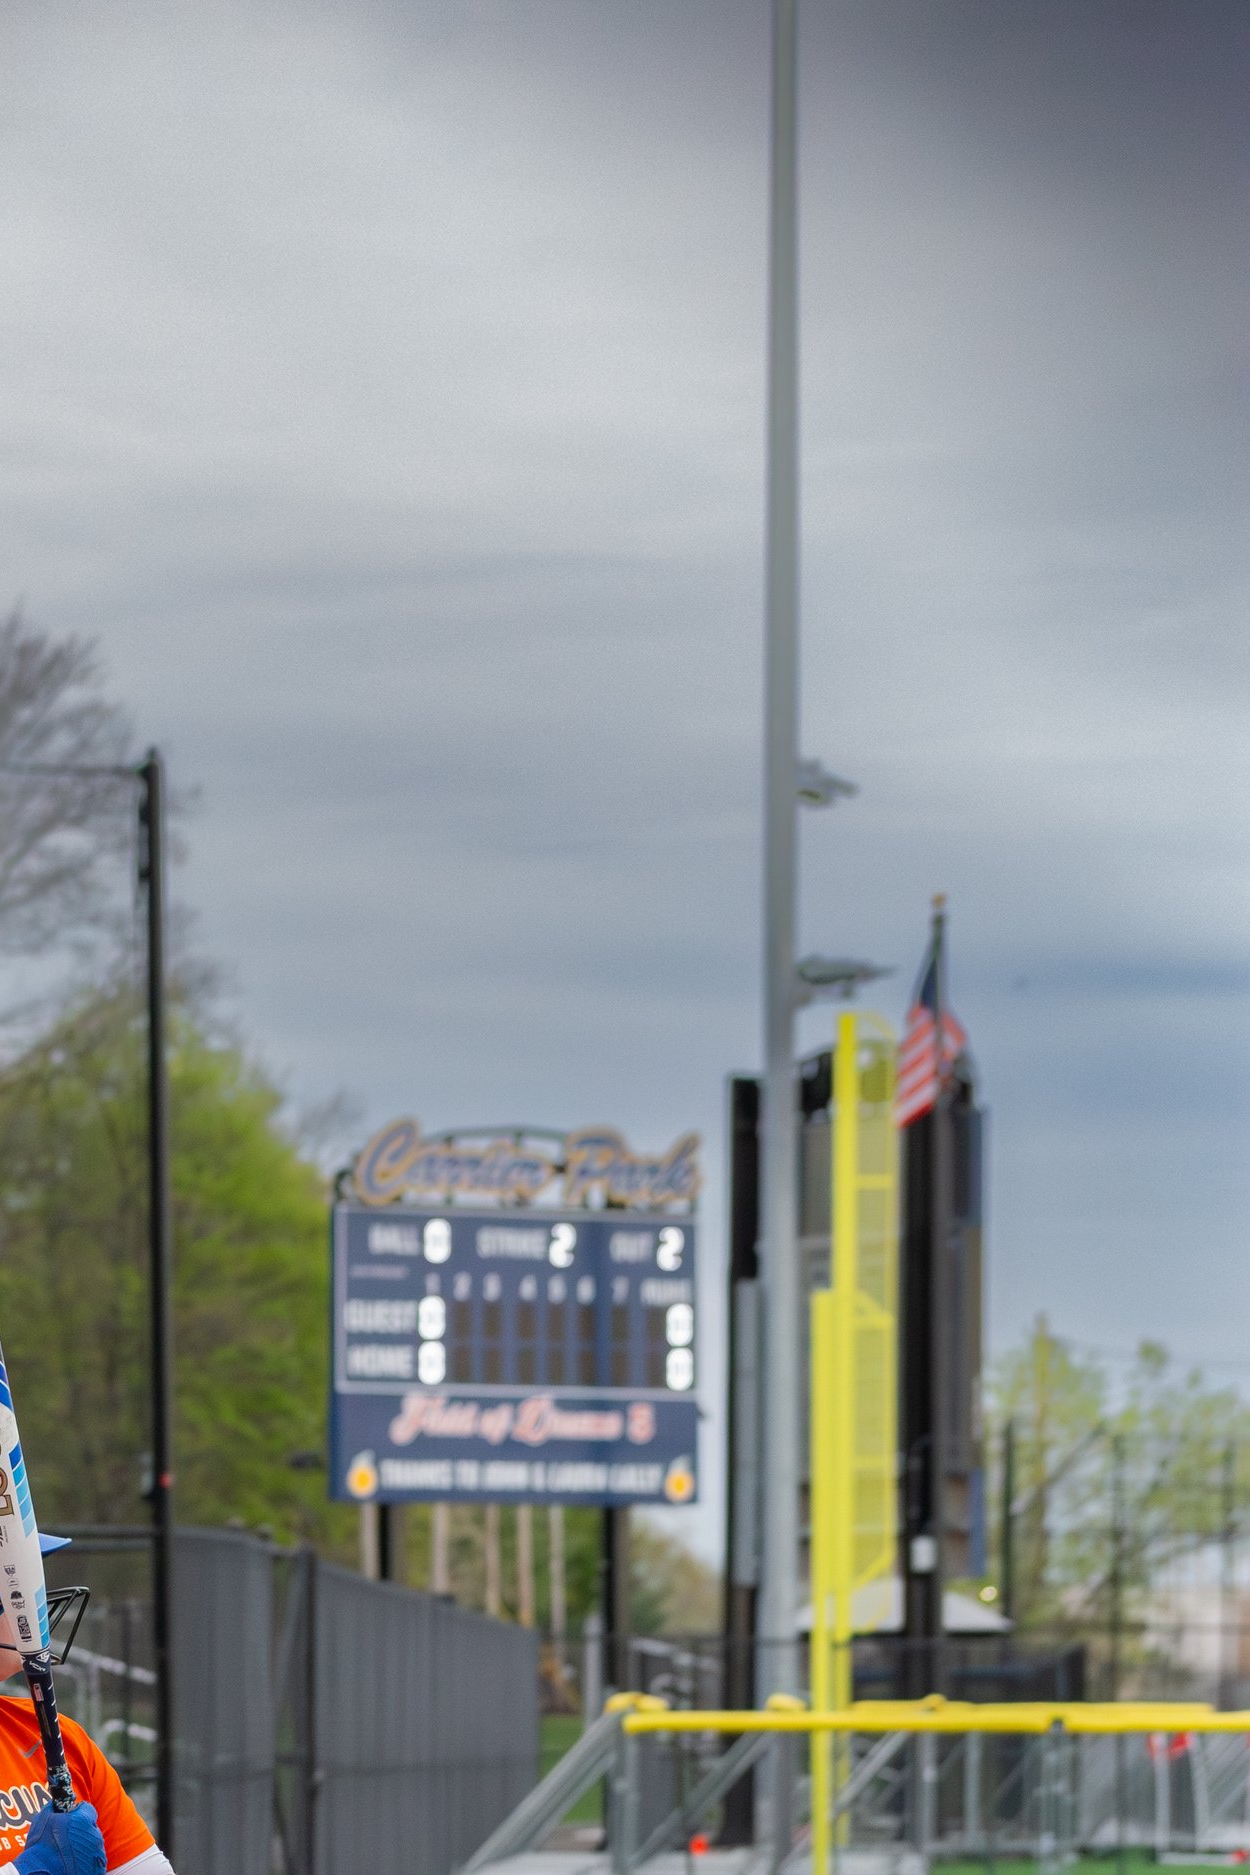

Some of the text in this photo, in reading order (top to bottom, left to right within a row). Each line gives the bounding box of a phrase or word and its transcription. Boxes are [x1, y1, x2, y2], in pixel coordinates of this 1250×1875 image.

[565, 1126, 703, 1207] Park
[367, 1224, 419, 1256] BALL
[424, 1218, 451, 1264] 0
[475, 1226, 547, 1259] STRIKE
[549, 1223, 577, 1268] 2
[609, 1231, 653, 1264] OUT
[657, 1226, 684, 1271] 2
[345, 1299, 417, 1335] GUEST
[418, 1295, 446, 1340] 0
[666, 1303, 694, 1348] 0
[347, 1345, 414, 1379] HOME
[418, 1340, 446, 1385] 0
[666, 1347, 694, 1391] 0
